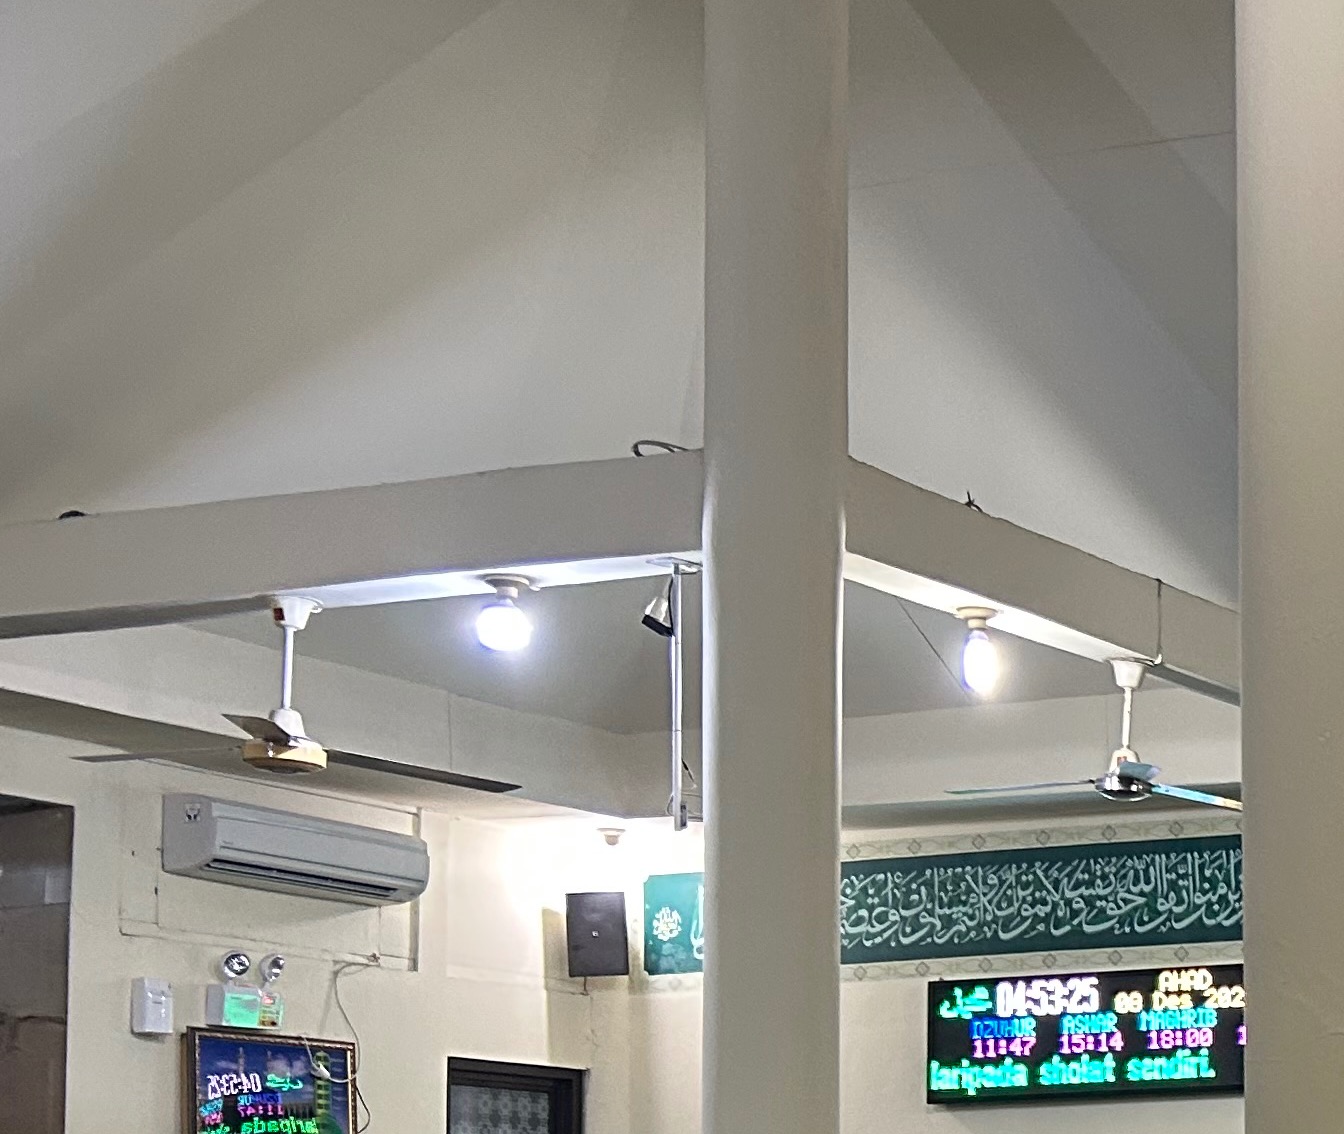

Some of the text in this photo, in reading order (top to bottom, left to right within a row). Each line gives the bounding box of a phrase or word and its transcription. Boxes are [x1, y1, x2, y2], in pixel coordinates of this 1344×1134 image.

[1158, 968, 1213, 991] AHAD
[1152, 990, 1194, 1011] Des
[1202, 985, 1245, 1009] 202
[1060, 1013, 1118, 1035] ASHAR
[1137, 1007, 1218, 1031] MAGHRIB
[972, 1037, 1037, 1058] 11:47
[1059, 1031, 1124, 1055] 15:14
[1147, 1027, 1213, 1050] 18:00
[1039, 1053, 1116, 1085] sholat
